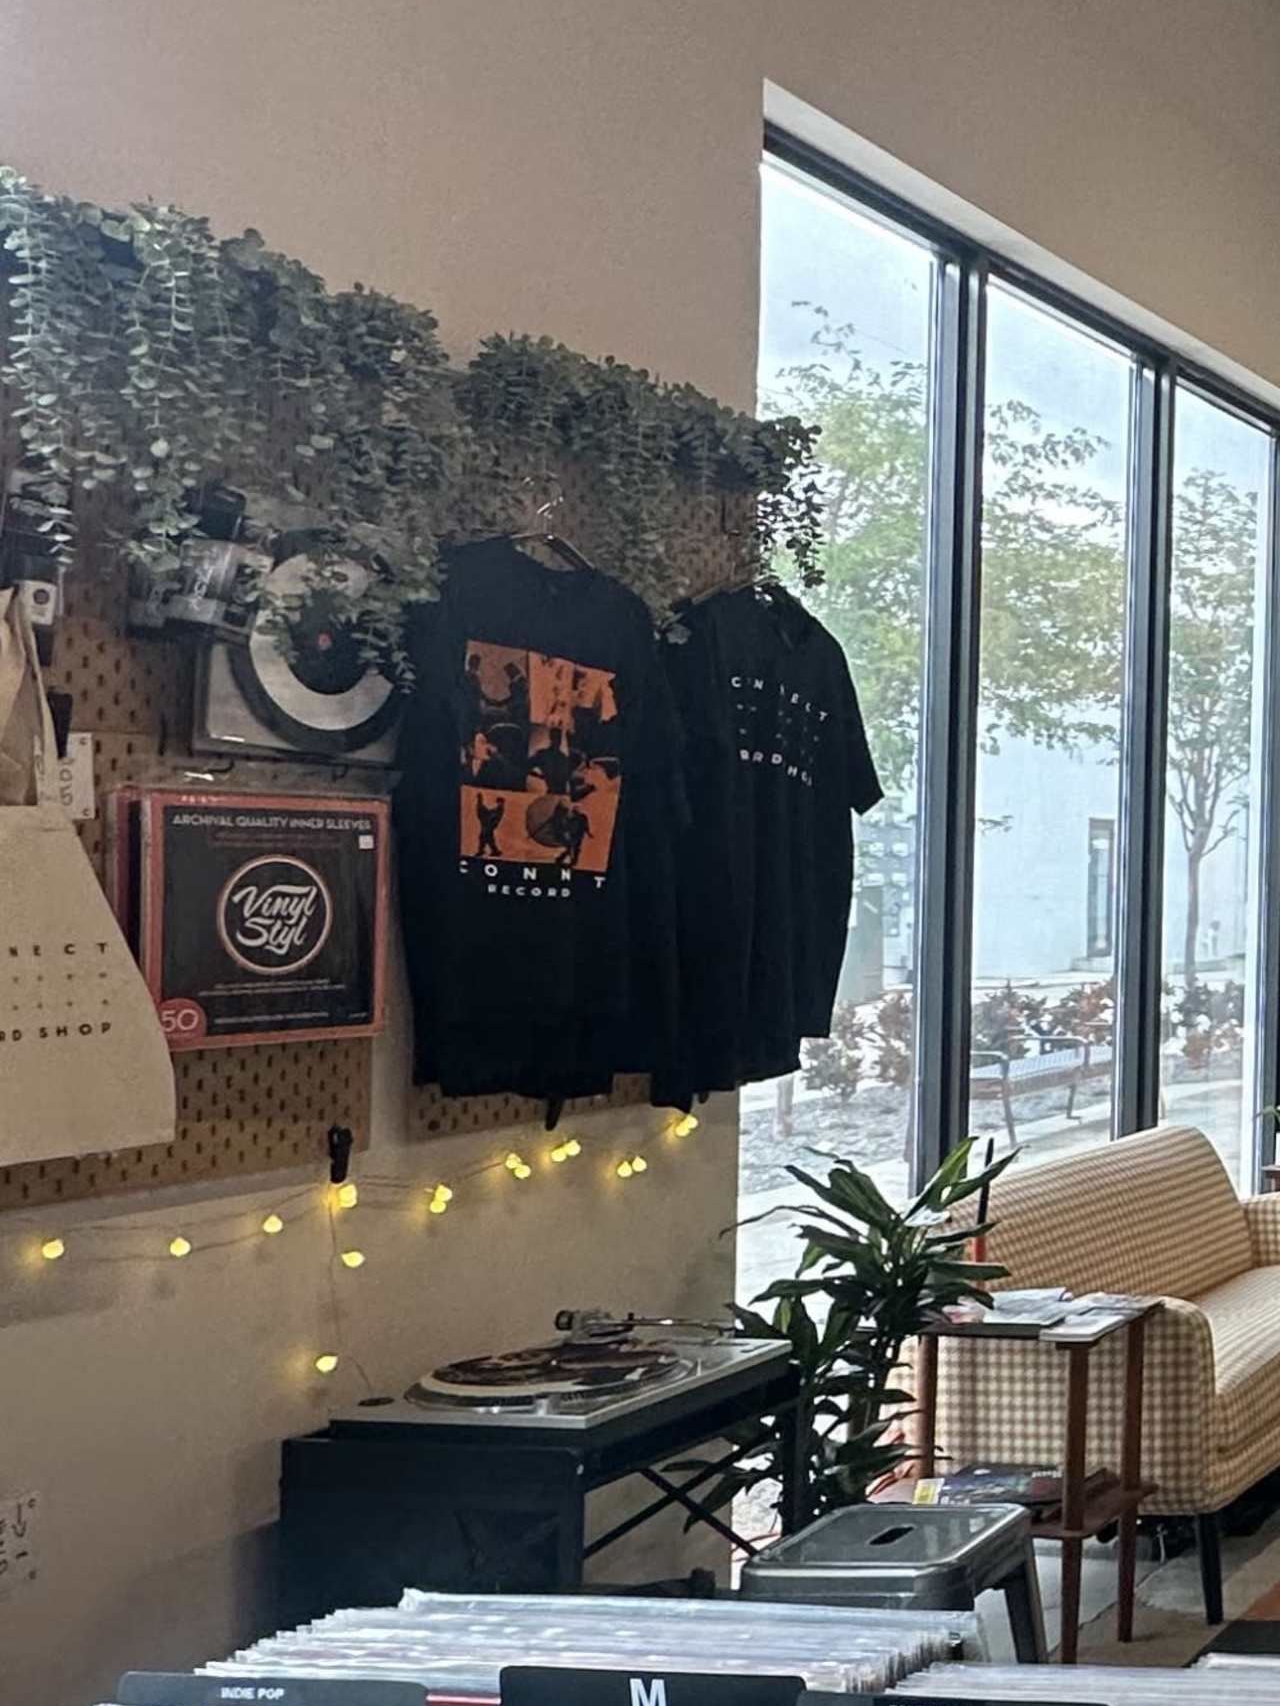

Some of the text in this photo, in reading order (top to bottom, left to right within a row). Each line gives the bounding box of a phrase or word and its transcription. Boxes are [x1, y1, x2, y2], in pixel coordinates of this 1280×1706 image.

[173, 815, 372, 831] ARCHIVAL QUALITY INNER SLEEVES
[487, 884, 571, 898] RECORD
[232, 885, 318, 924] Vinyl
[236, 917, 307, 955] Styl
[161, 1009, 199, 1032] 50
[39, 1022, 111, 1039] SHOP
[221, 1687, 284, 1700] INDIE POP
